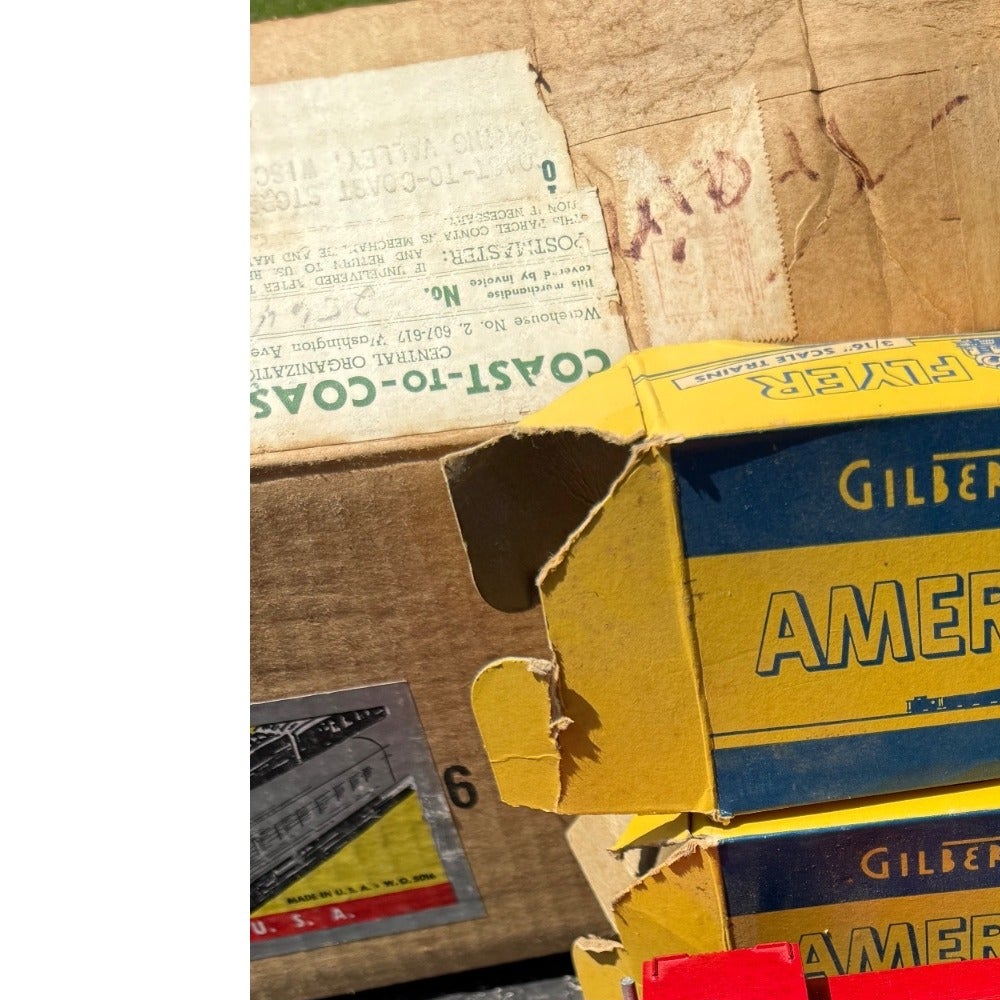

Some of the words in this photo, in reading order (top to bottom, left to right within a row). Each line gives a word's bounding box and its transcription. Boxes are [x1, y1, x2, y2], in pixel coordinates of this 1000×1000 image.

[394, 249, 423, 261] AND
[304, 262, 324, 274] TO
[521, 270, 538, 282] by
[469, 274, 514, 287] invoice
[424, 285, 462, 309] No.
[397, 324, 452, 343] 607-617
[480, 318, 508, 333] No.
[372, 345, 453, 367] CENTRAL
[774, 346, 836, 365] SCALE
[694, 357, 770, 384] TRAINS
[745, 355, 974, 402] FLYER
[443, 764, 479, 810] 6
[287, 893, 317, 905] MADE
[319, 891, 333, 899] IN
